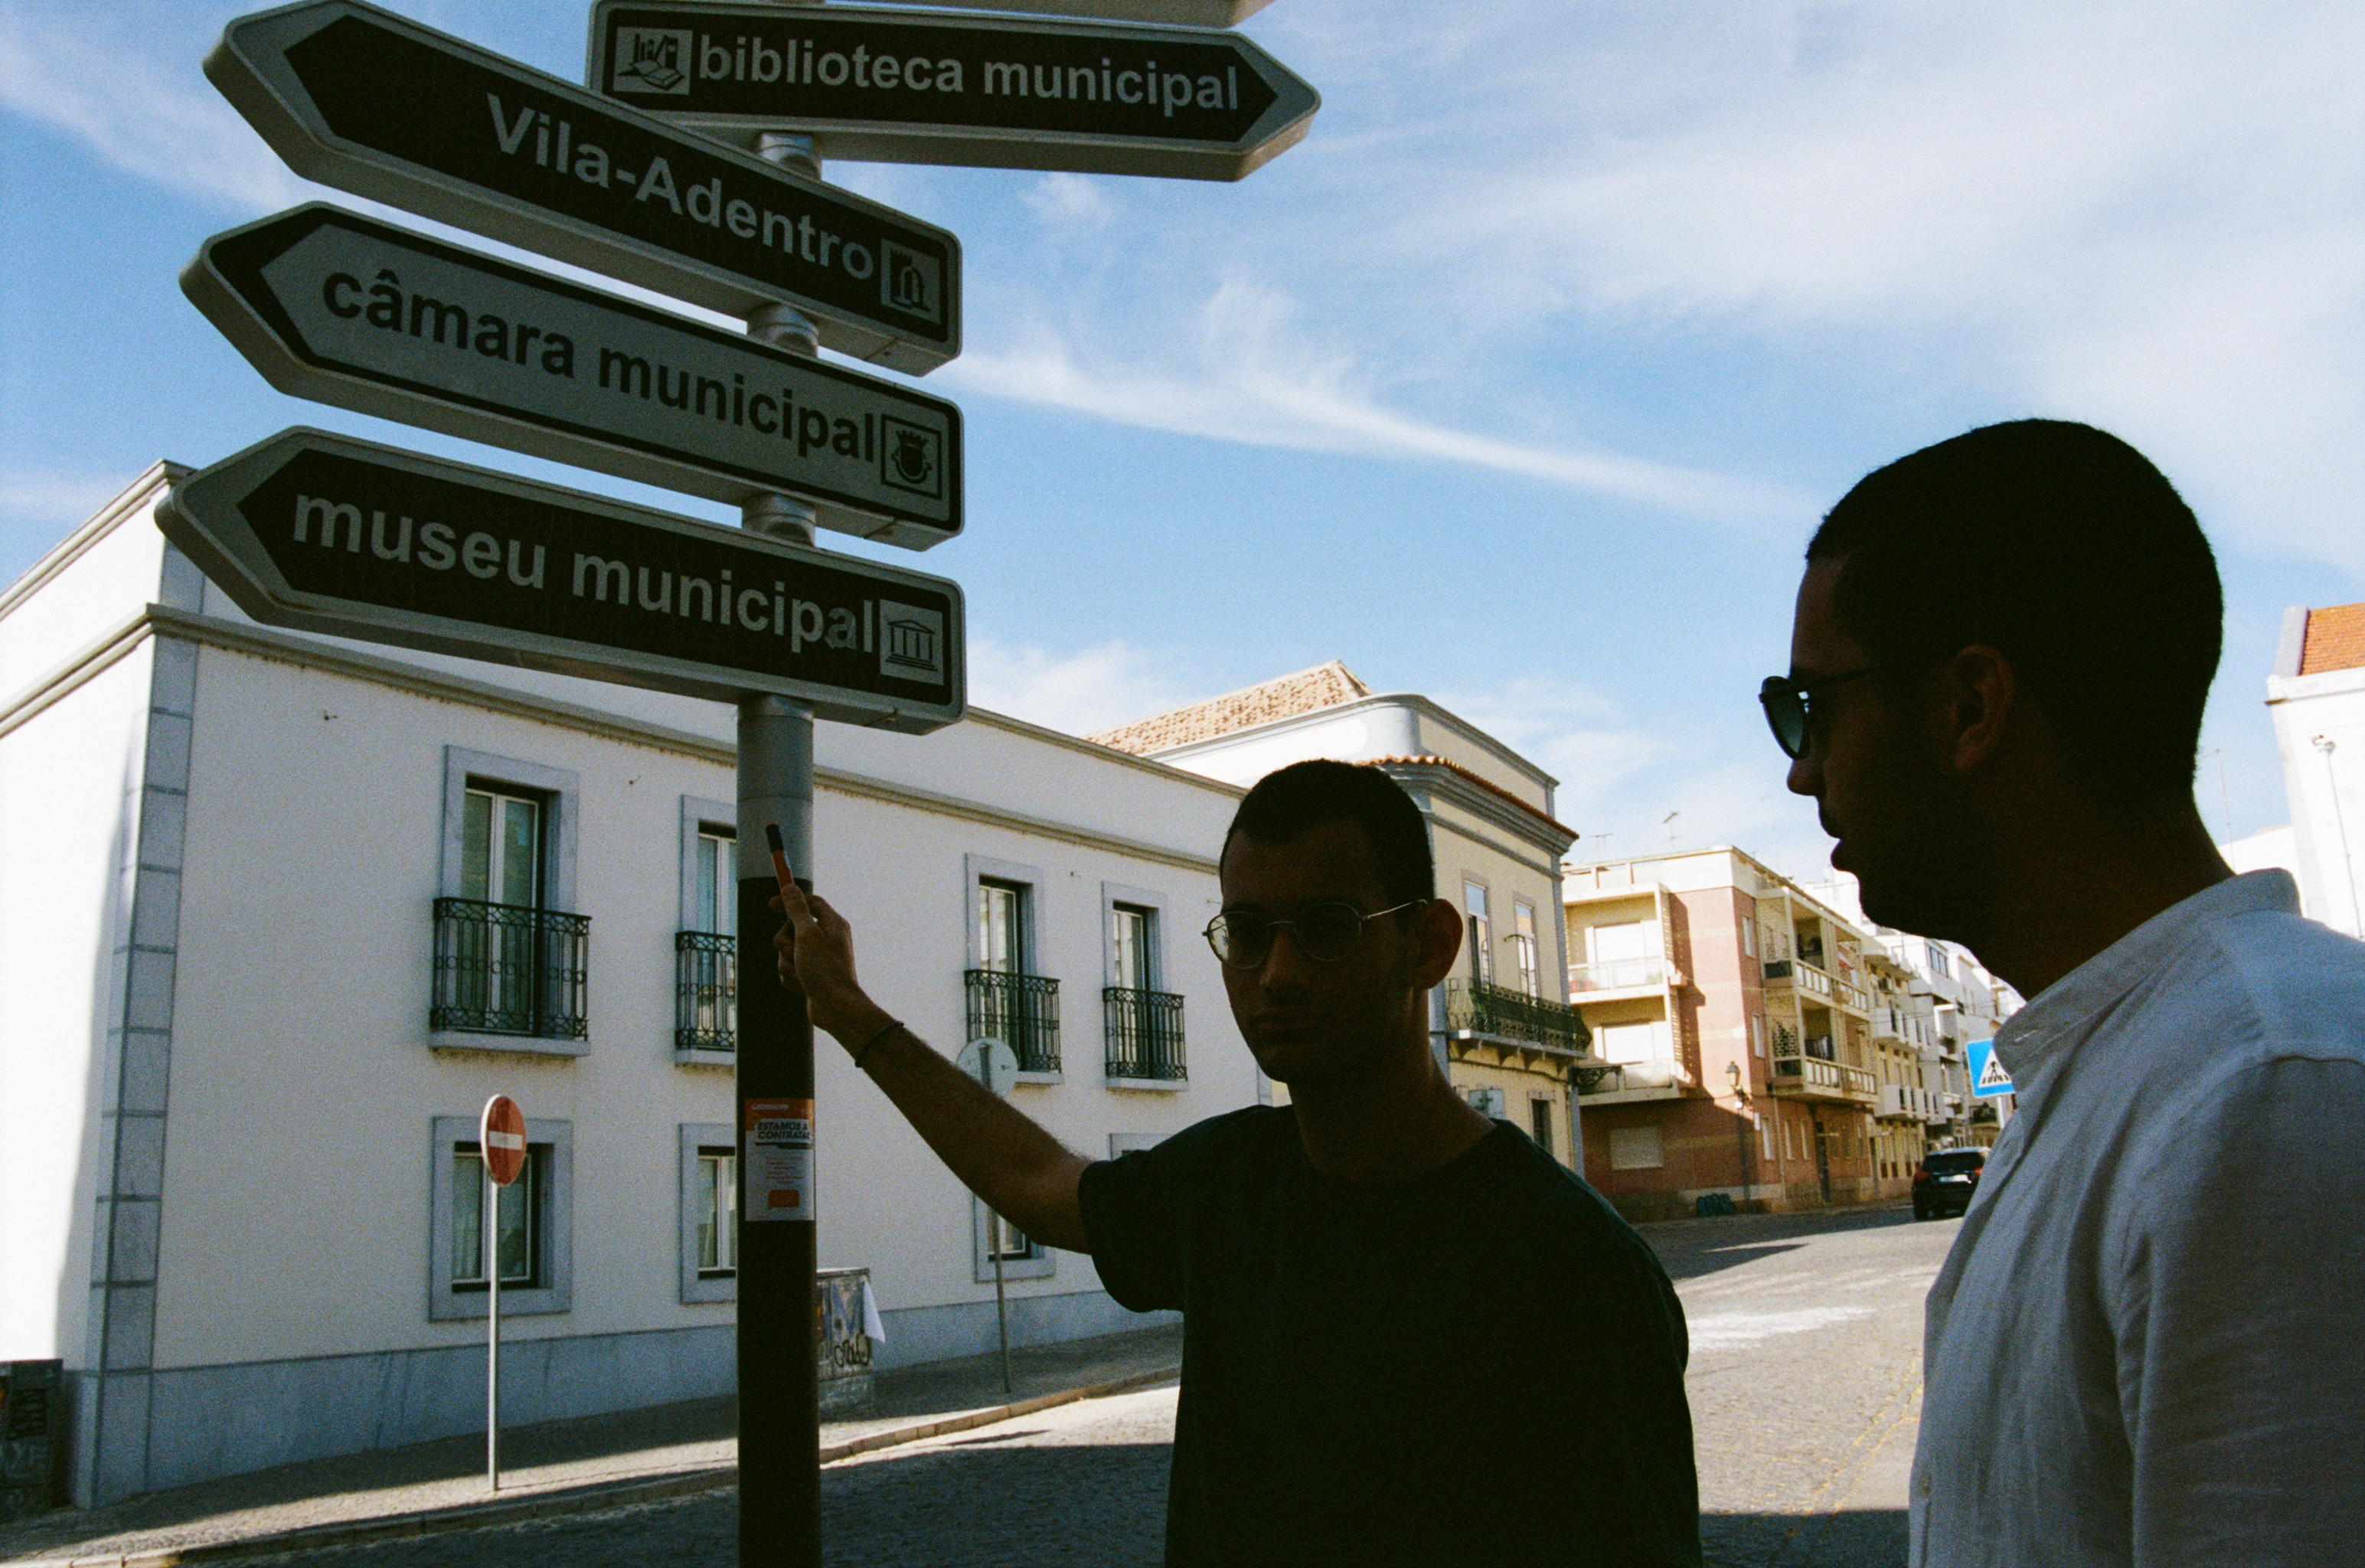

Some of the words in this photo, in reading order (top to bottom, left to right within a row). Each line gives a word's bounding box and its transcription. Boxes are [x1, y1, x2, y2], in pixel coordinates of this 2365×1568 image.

[698, 34, 964, 93] biblioteca
[984, 59, 1238, 116] municipal
[486, 93, 874, 280] Vila-Adentro
[323, 268, 575, 379] câmara
[599, 346, 874, 462] municipal
[293, 493, 546, 590] museu
[572, 550, 874, 655] municipal
[757, 1122, 802, 1131] ESTAMOS
